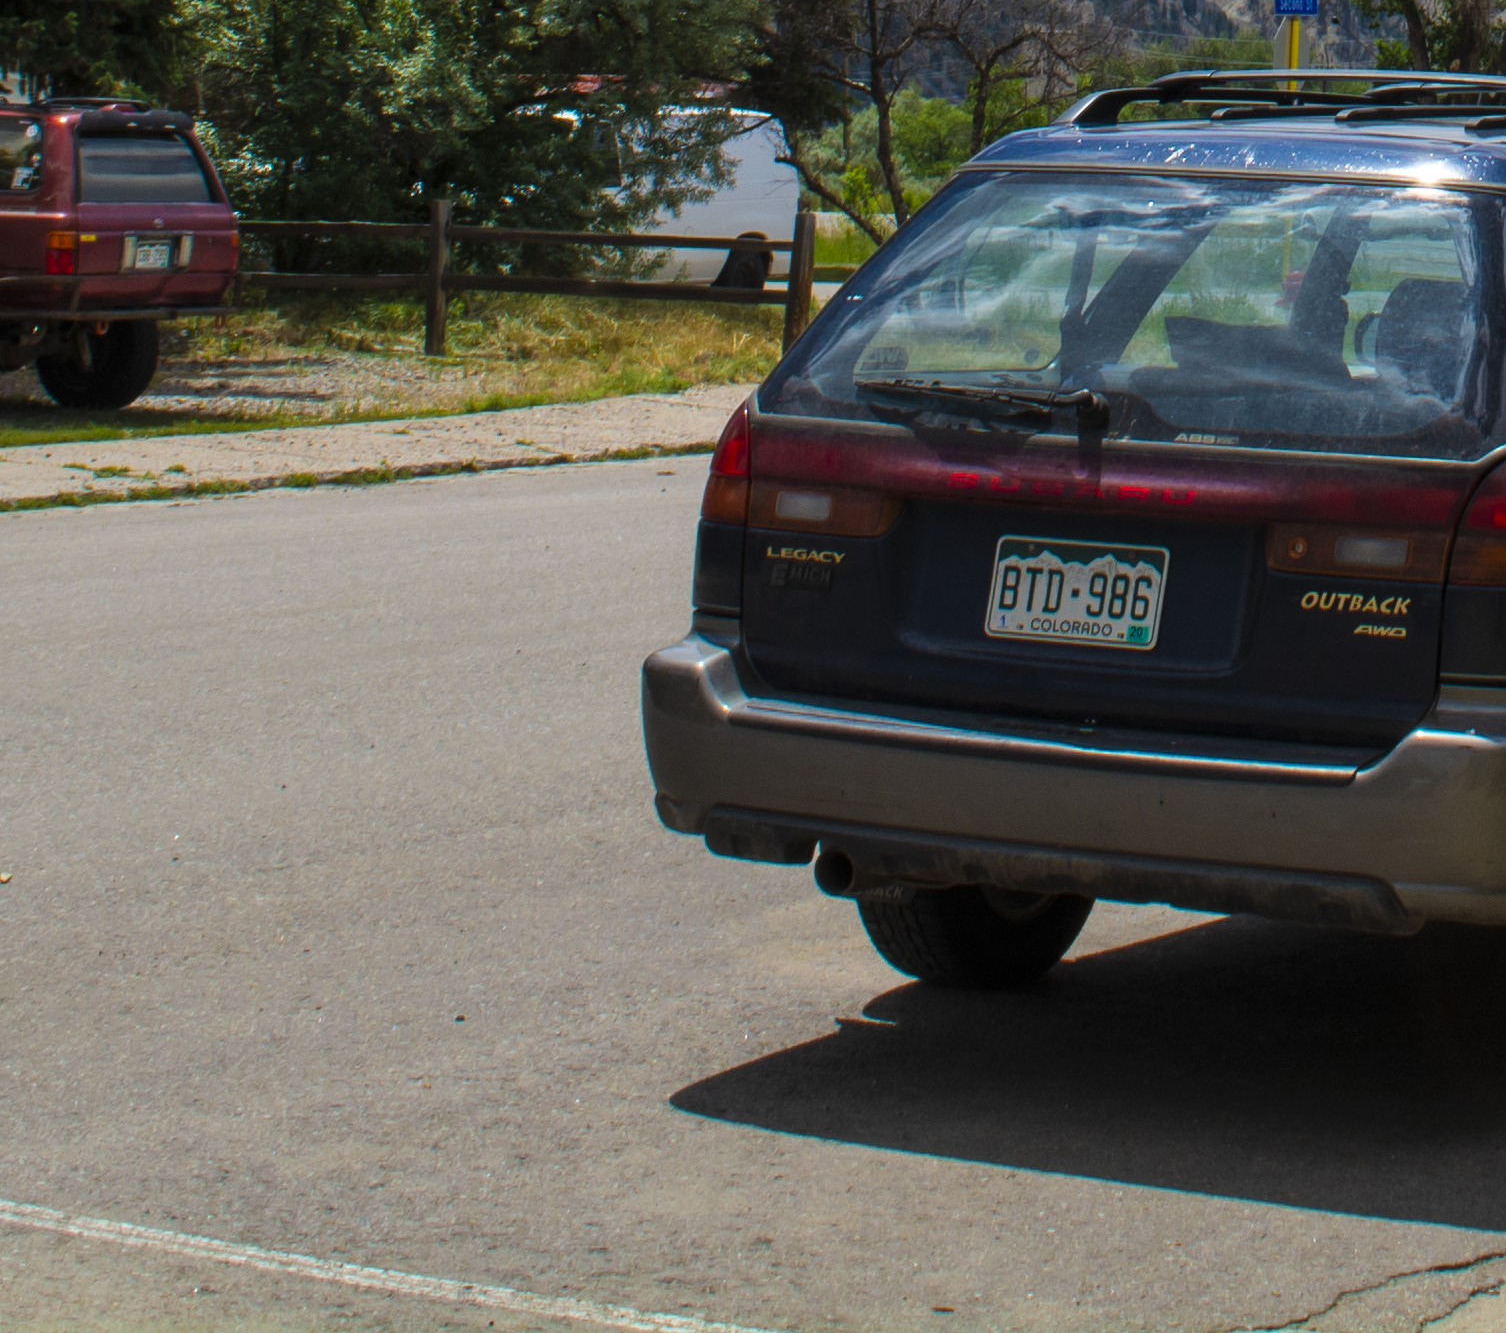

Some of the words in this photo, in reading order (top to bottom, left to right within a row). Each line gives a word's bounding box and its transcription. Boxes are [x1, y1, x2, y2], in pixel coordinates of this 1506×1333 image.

[949, 472, 1198, 506] SUBARU
[766, 545, 845, 564] LEGACY
[1301, 591, 1411, 614] OUTBACK
[1030, 616, 1113, 638] COLORADO
[1353, 624, 1407, 637] AWD
